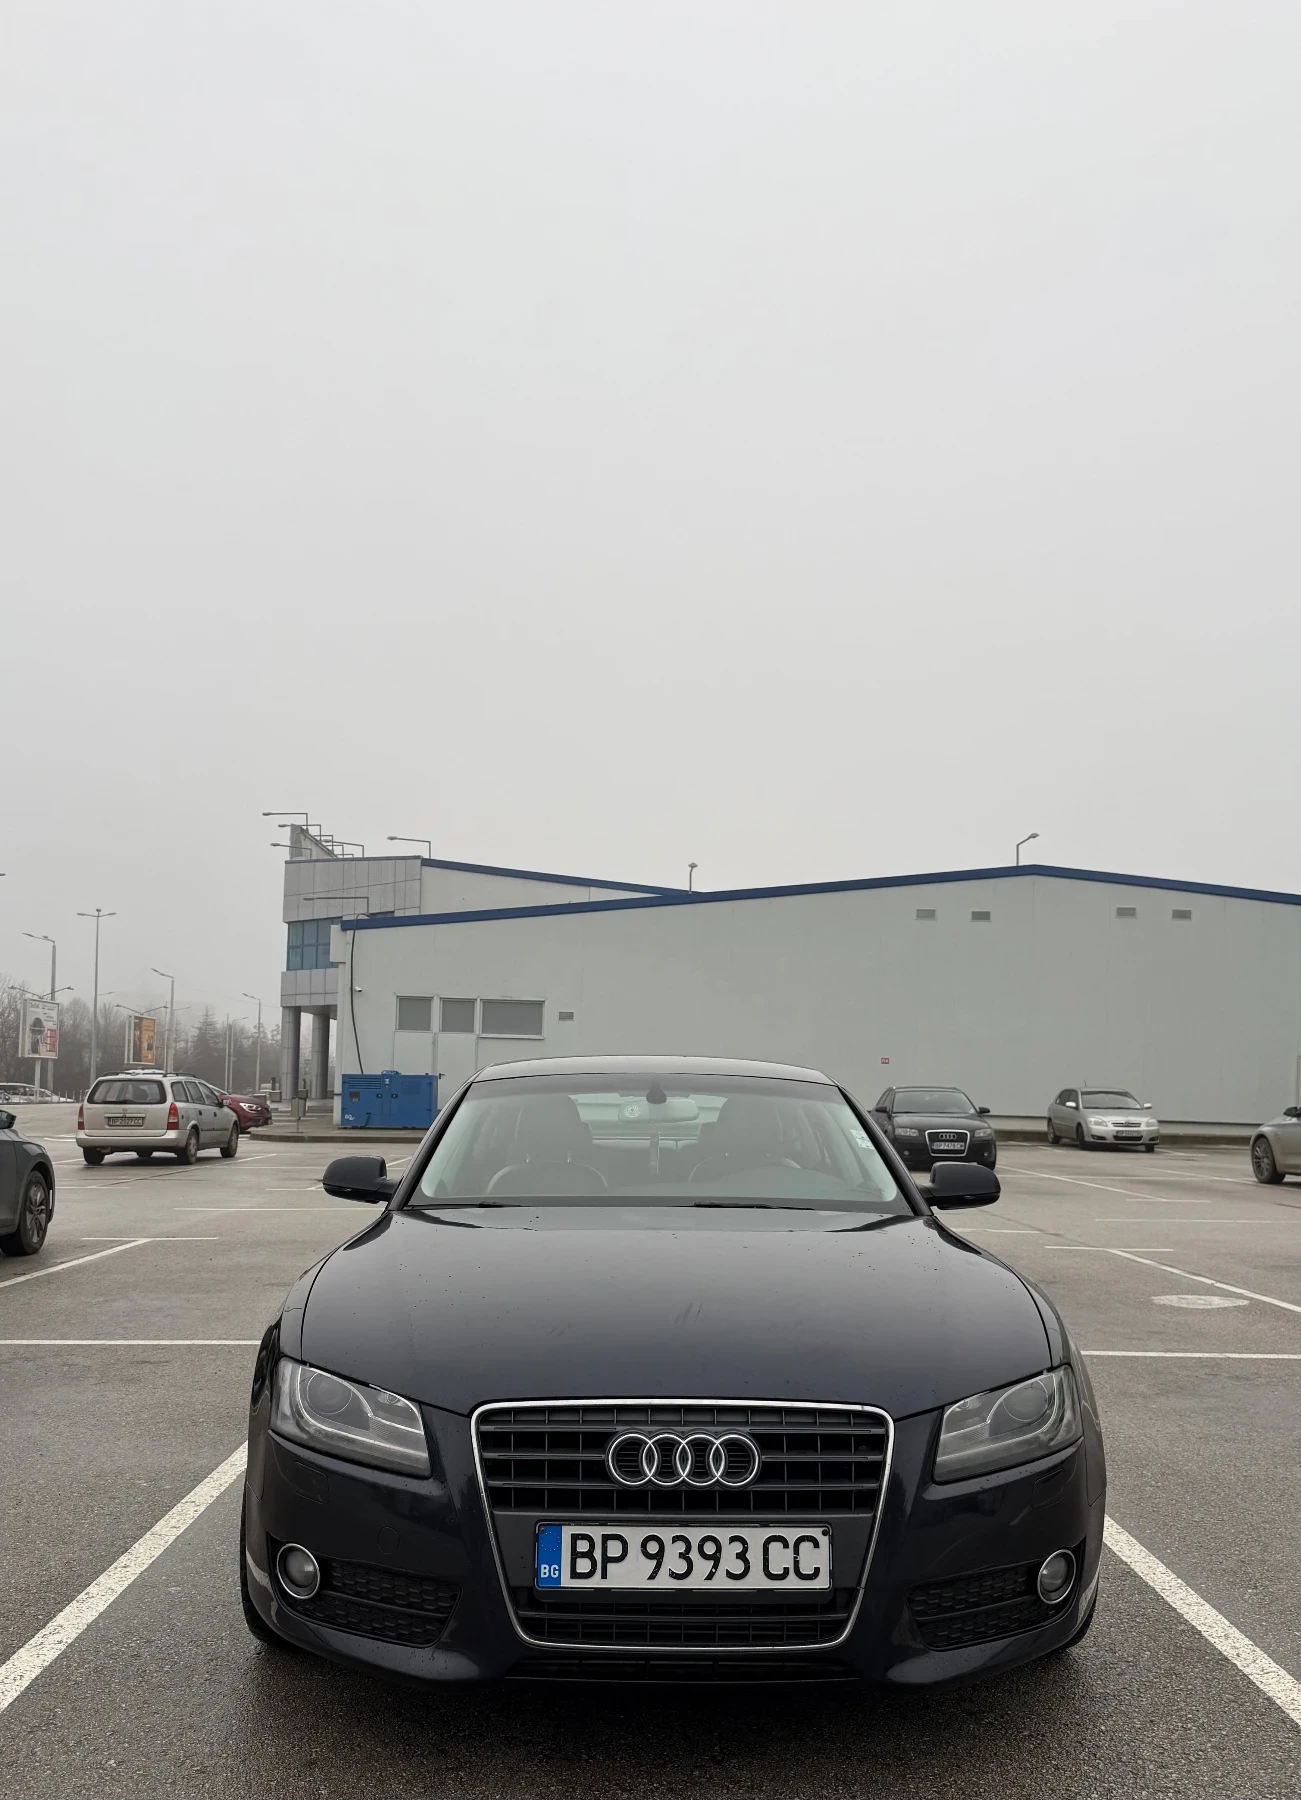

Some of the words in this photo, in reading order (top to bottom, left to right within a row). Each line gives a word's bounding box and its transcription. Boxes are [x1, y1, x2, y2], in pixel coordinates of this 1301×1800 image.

[540, 1564, 560, 1578] BG
[570, 1533, 628, 1580] BP
[640, 1534, 751, 1581] 9393
[762, 1534, 820, 1581] CC
